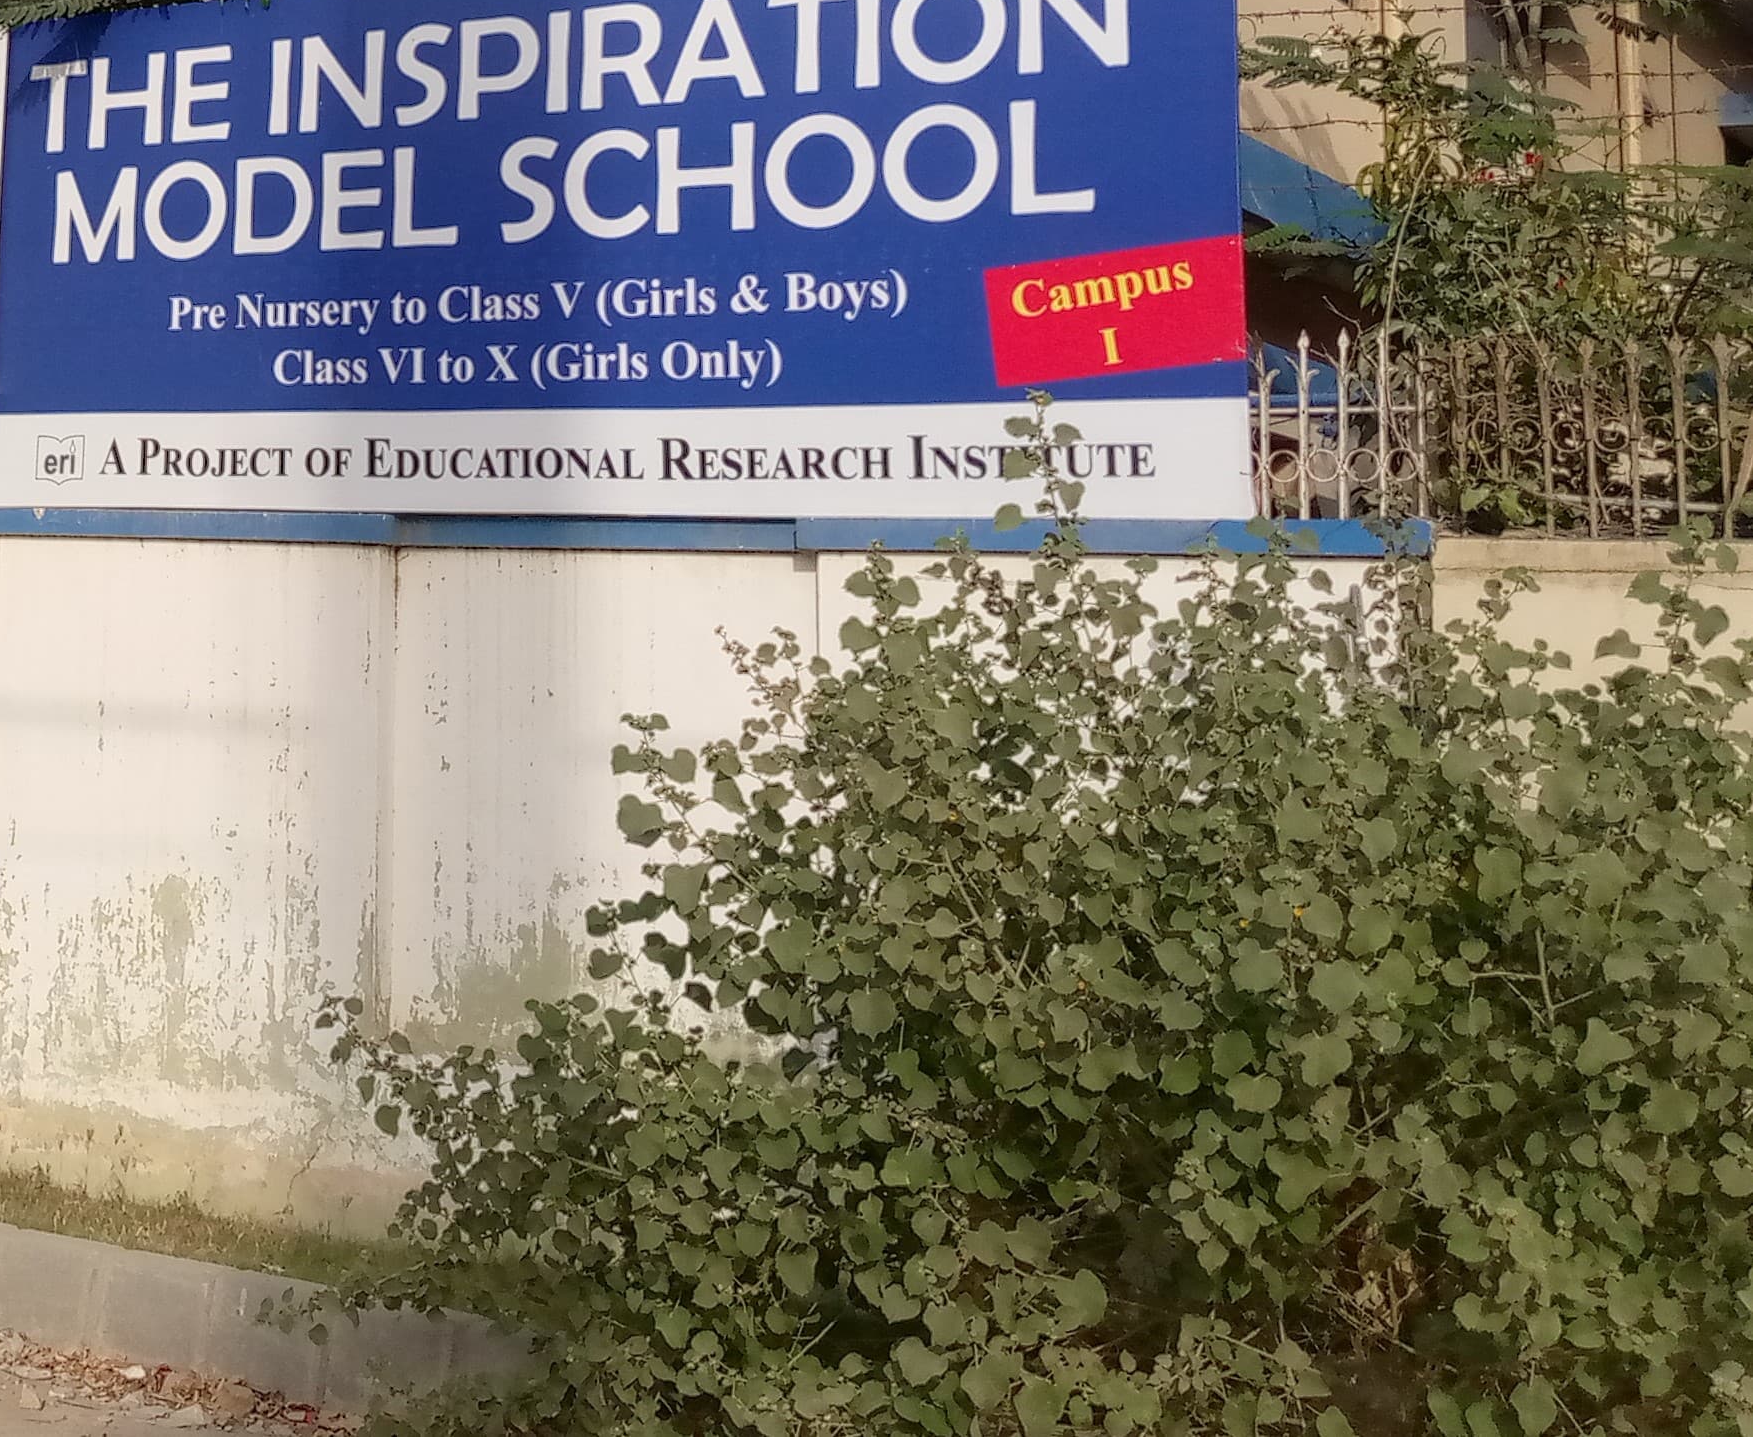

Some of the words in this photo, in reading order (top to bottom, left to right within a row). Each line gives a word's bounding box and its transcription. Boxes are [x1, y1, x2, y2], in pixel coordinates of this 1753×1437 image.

[29, 44, 232, 154] THE
[52, 146, 459, 265] MODEL
[499, 99, 1096, 244] SCHOOL
[168, 295, 227, 332] Pre
[235, 289, 381, 335] Nursery
[390, 290, 427, 326] to
[437, 285, 541, 325] Class
[551, 282, 585, 320] V
[597, 275, 718, 328] (Girls
[730, 276, 771, 316] &
[783, 269, 909, 322] Boys)
[1011, 260, 1195, 319] Campus
[272, 347, 369, 387] Class
[378, 346, 428, 385] VI
[437, 349, 476, 383] to
[485, 344, 520, 382] X
[530, 341, 649, 391] (Girls
[660, 338, 784, 390] Only)
[1097, 327, 1124, 367] I
[42, 443, 78, 476] eri
[99, 440, 128, 477] A
[136, 437, 294, 478] PROJECT
[304, 447, 353, 478] OF
[363, 437, 646, 481] EDUCATIONAL
[656, 436, 893, 482] RESEARCH
[907, 434, 1156, 480] INSTTUTE
